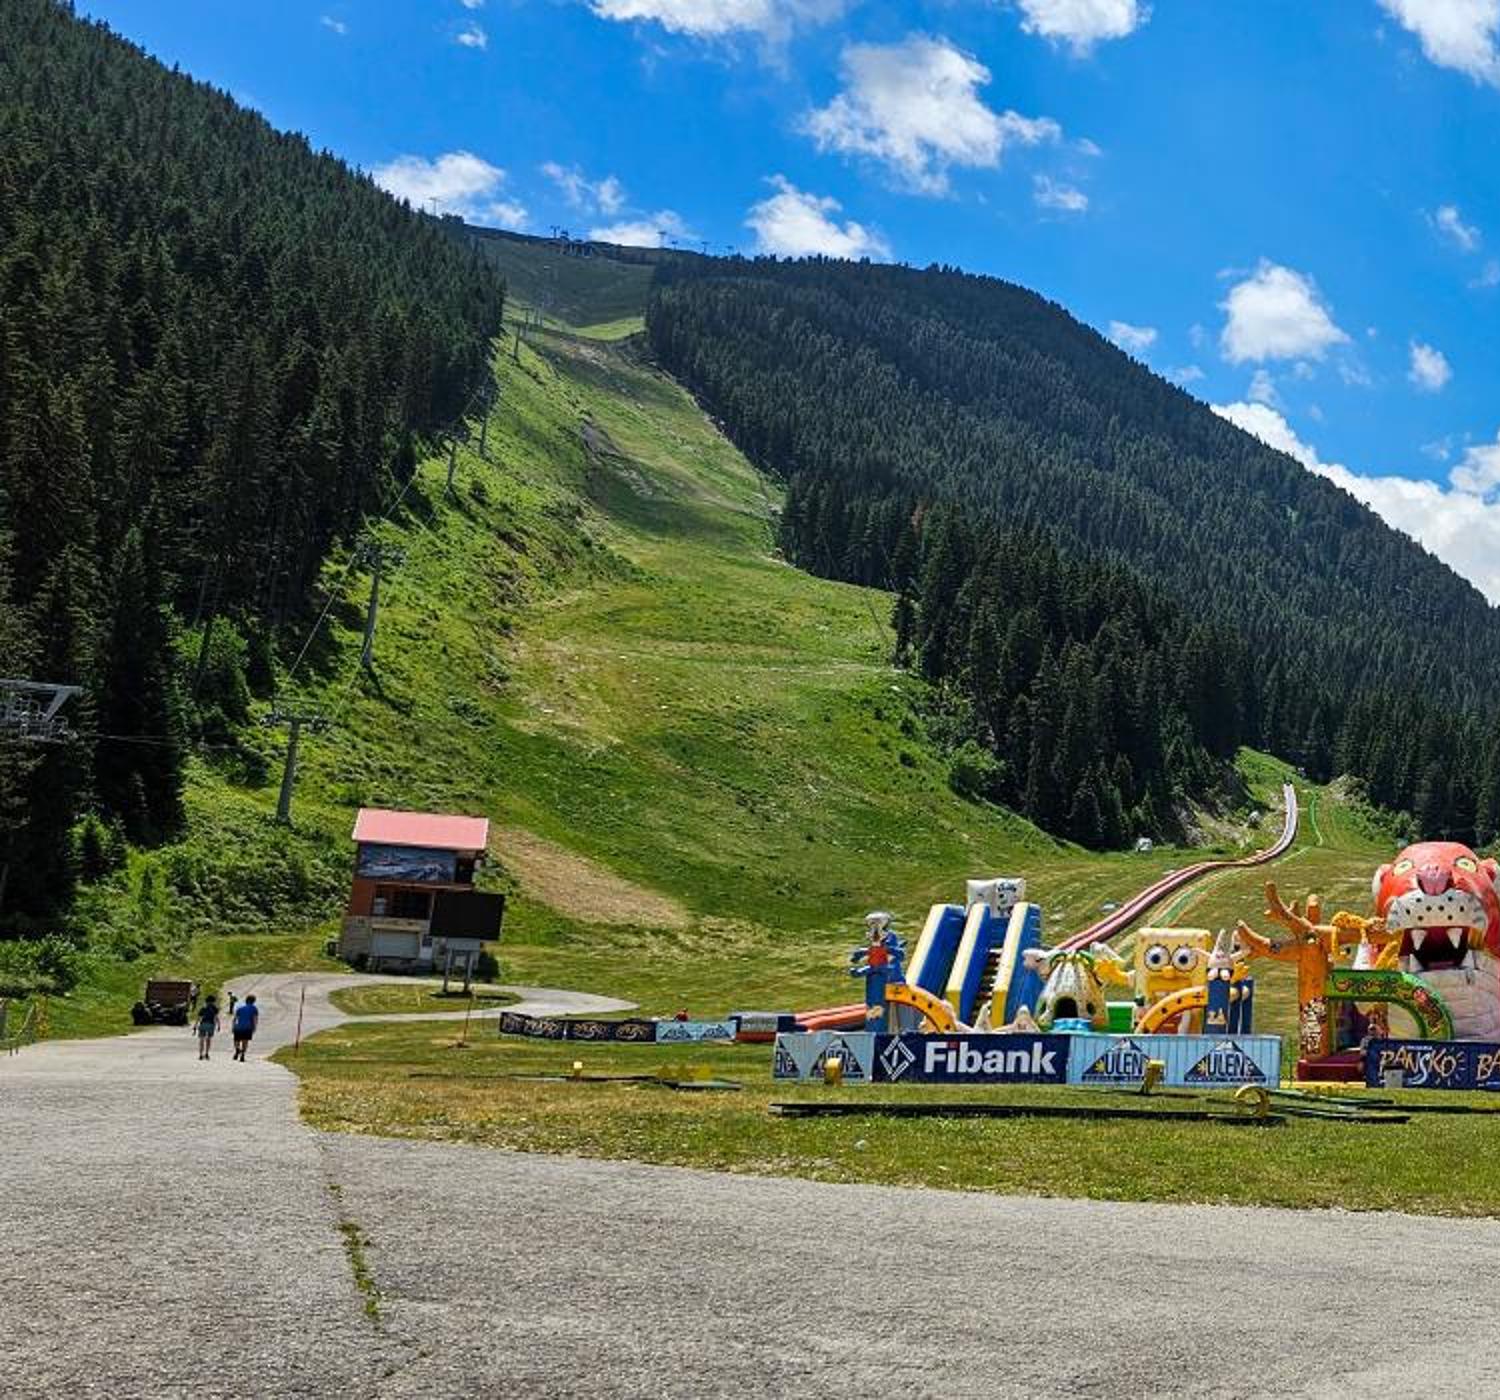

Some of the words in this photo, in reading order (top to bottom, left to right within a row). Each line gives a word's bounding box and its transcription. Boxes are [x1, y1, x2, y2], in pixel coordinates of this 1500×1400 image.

[924, 1041, 1057, 1074] Fibank
[1105, 1051, 1144, 1076] ULEN
[1208, 1051, 1246, 1077] ULEN
